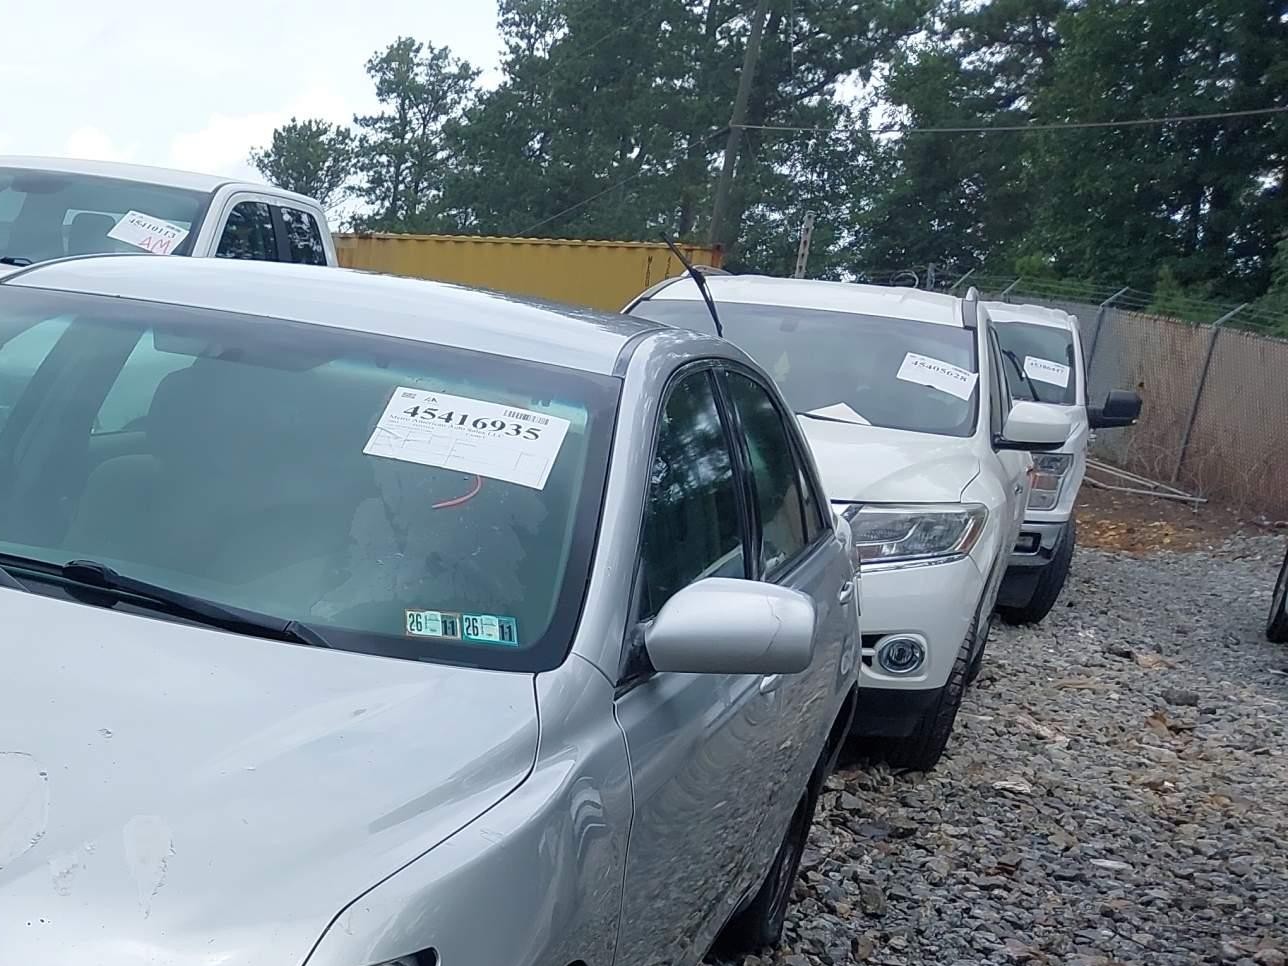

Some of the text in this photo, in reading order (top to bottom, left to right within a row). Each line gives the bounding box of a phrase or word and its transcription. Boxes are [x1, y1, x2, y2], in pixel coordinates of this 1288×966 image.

[138, 236, 172, 254] AM
[912, 360, 968, 382] 45405628
[403, 405, 542, 441] 45416935
[408, 613, 456, 636] 26 11
[464, 617, 513, 642] 26 11
